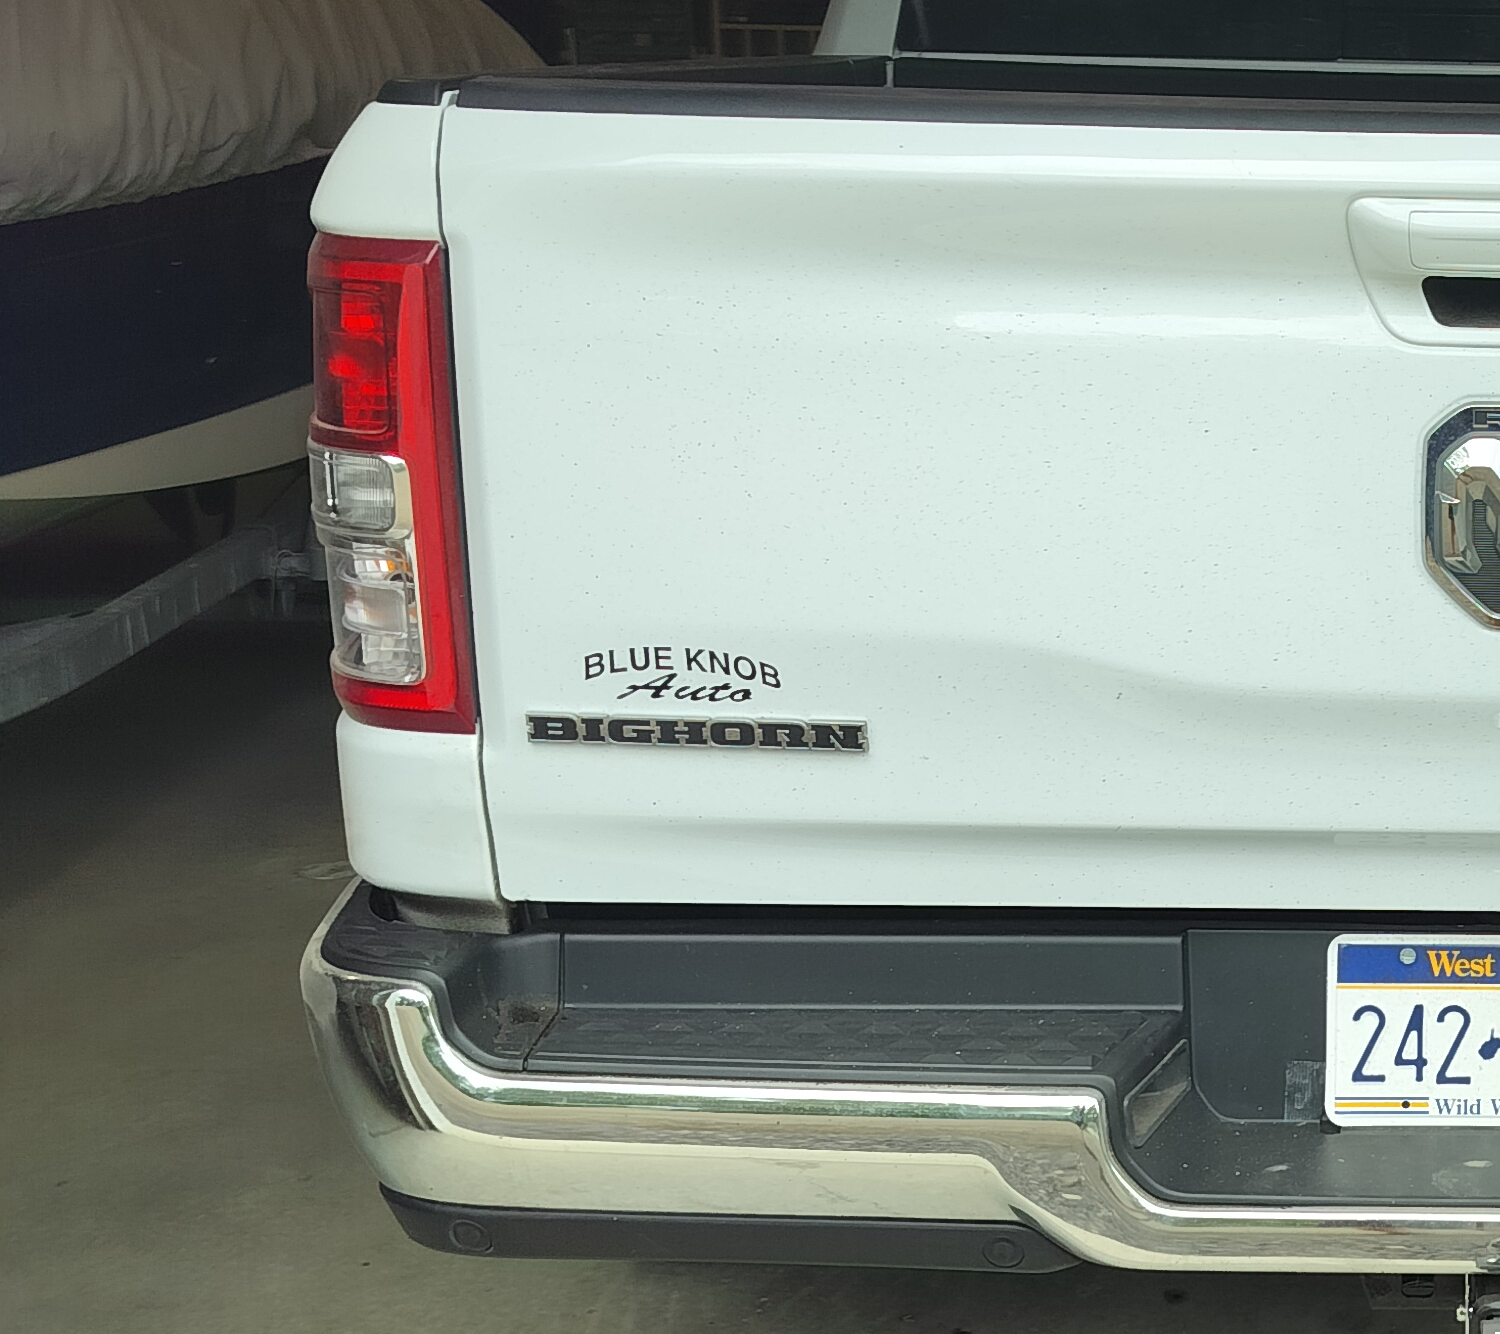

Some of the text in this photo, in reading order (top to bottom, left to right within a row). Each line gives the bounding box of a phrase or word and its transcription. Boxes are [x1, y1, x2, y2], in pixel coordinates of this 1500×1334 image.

[583, 645, 782, 689] BLUE KNOB
[616, 671, 753, 703] Auto
[525, 710, 871, 753] BIGHORN
[1426, 949, 1496, 979] West
[1351, 1003, 1472, 1085] 242
[1435, 1098, 1482, 1117] Wild
